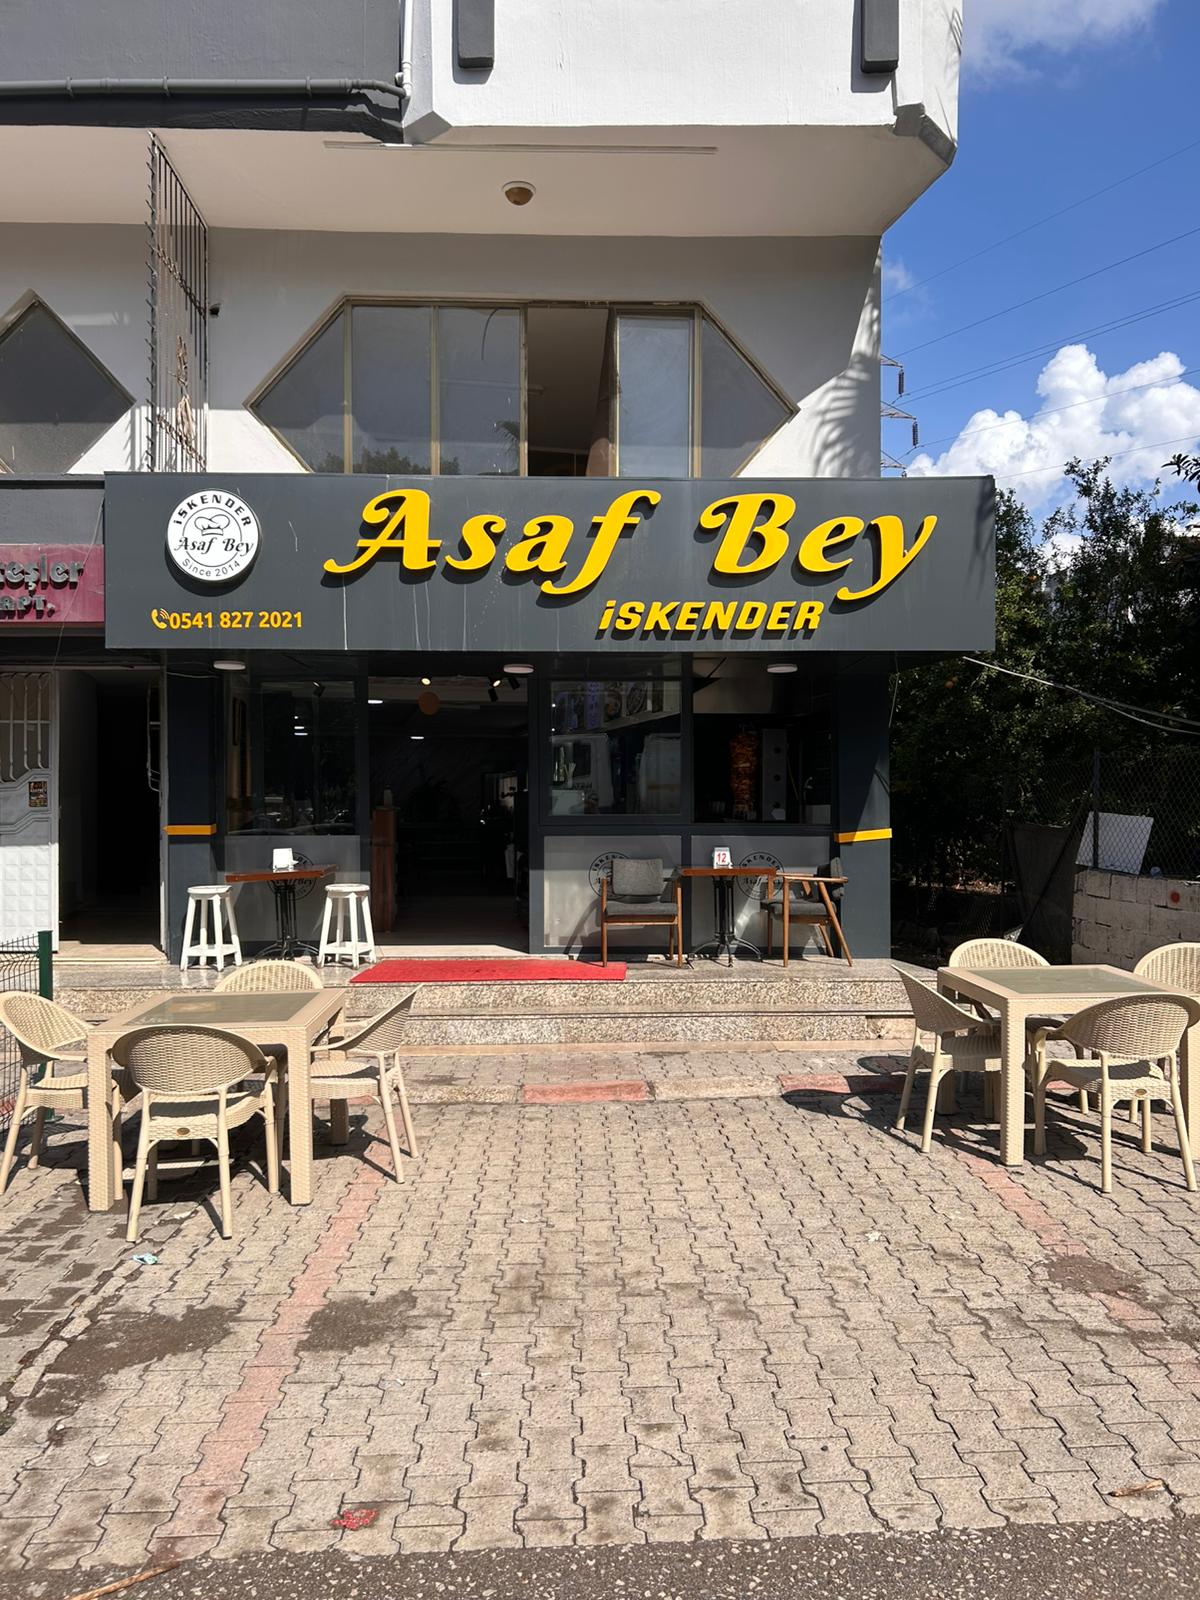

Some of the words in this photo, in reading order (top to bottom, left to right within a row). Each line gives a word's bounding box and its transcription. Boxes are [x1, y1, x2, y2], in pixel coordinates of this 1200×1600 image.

[173, 536, 217, 554] Asaf
[222, 538, 254, 556] Bey
[323, 488, 662, 595] Asaf
[699, 493, 938, 600] Bey
[182, 558, 212, 577] Since
[214, 560, 241, 577] 2014
[168, 611, 213, 629] 0541
[219, 611, 254, 629] 827
[258, 611, 302, 629] 2021
[717, 852, 727, 863] 12
